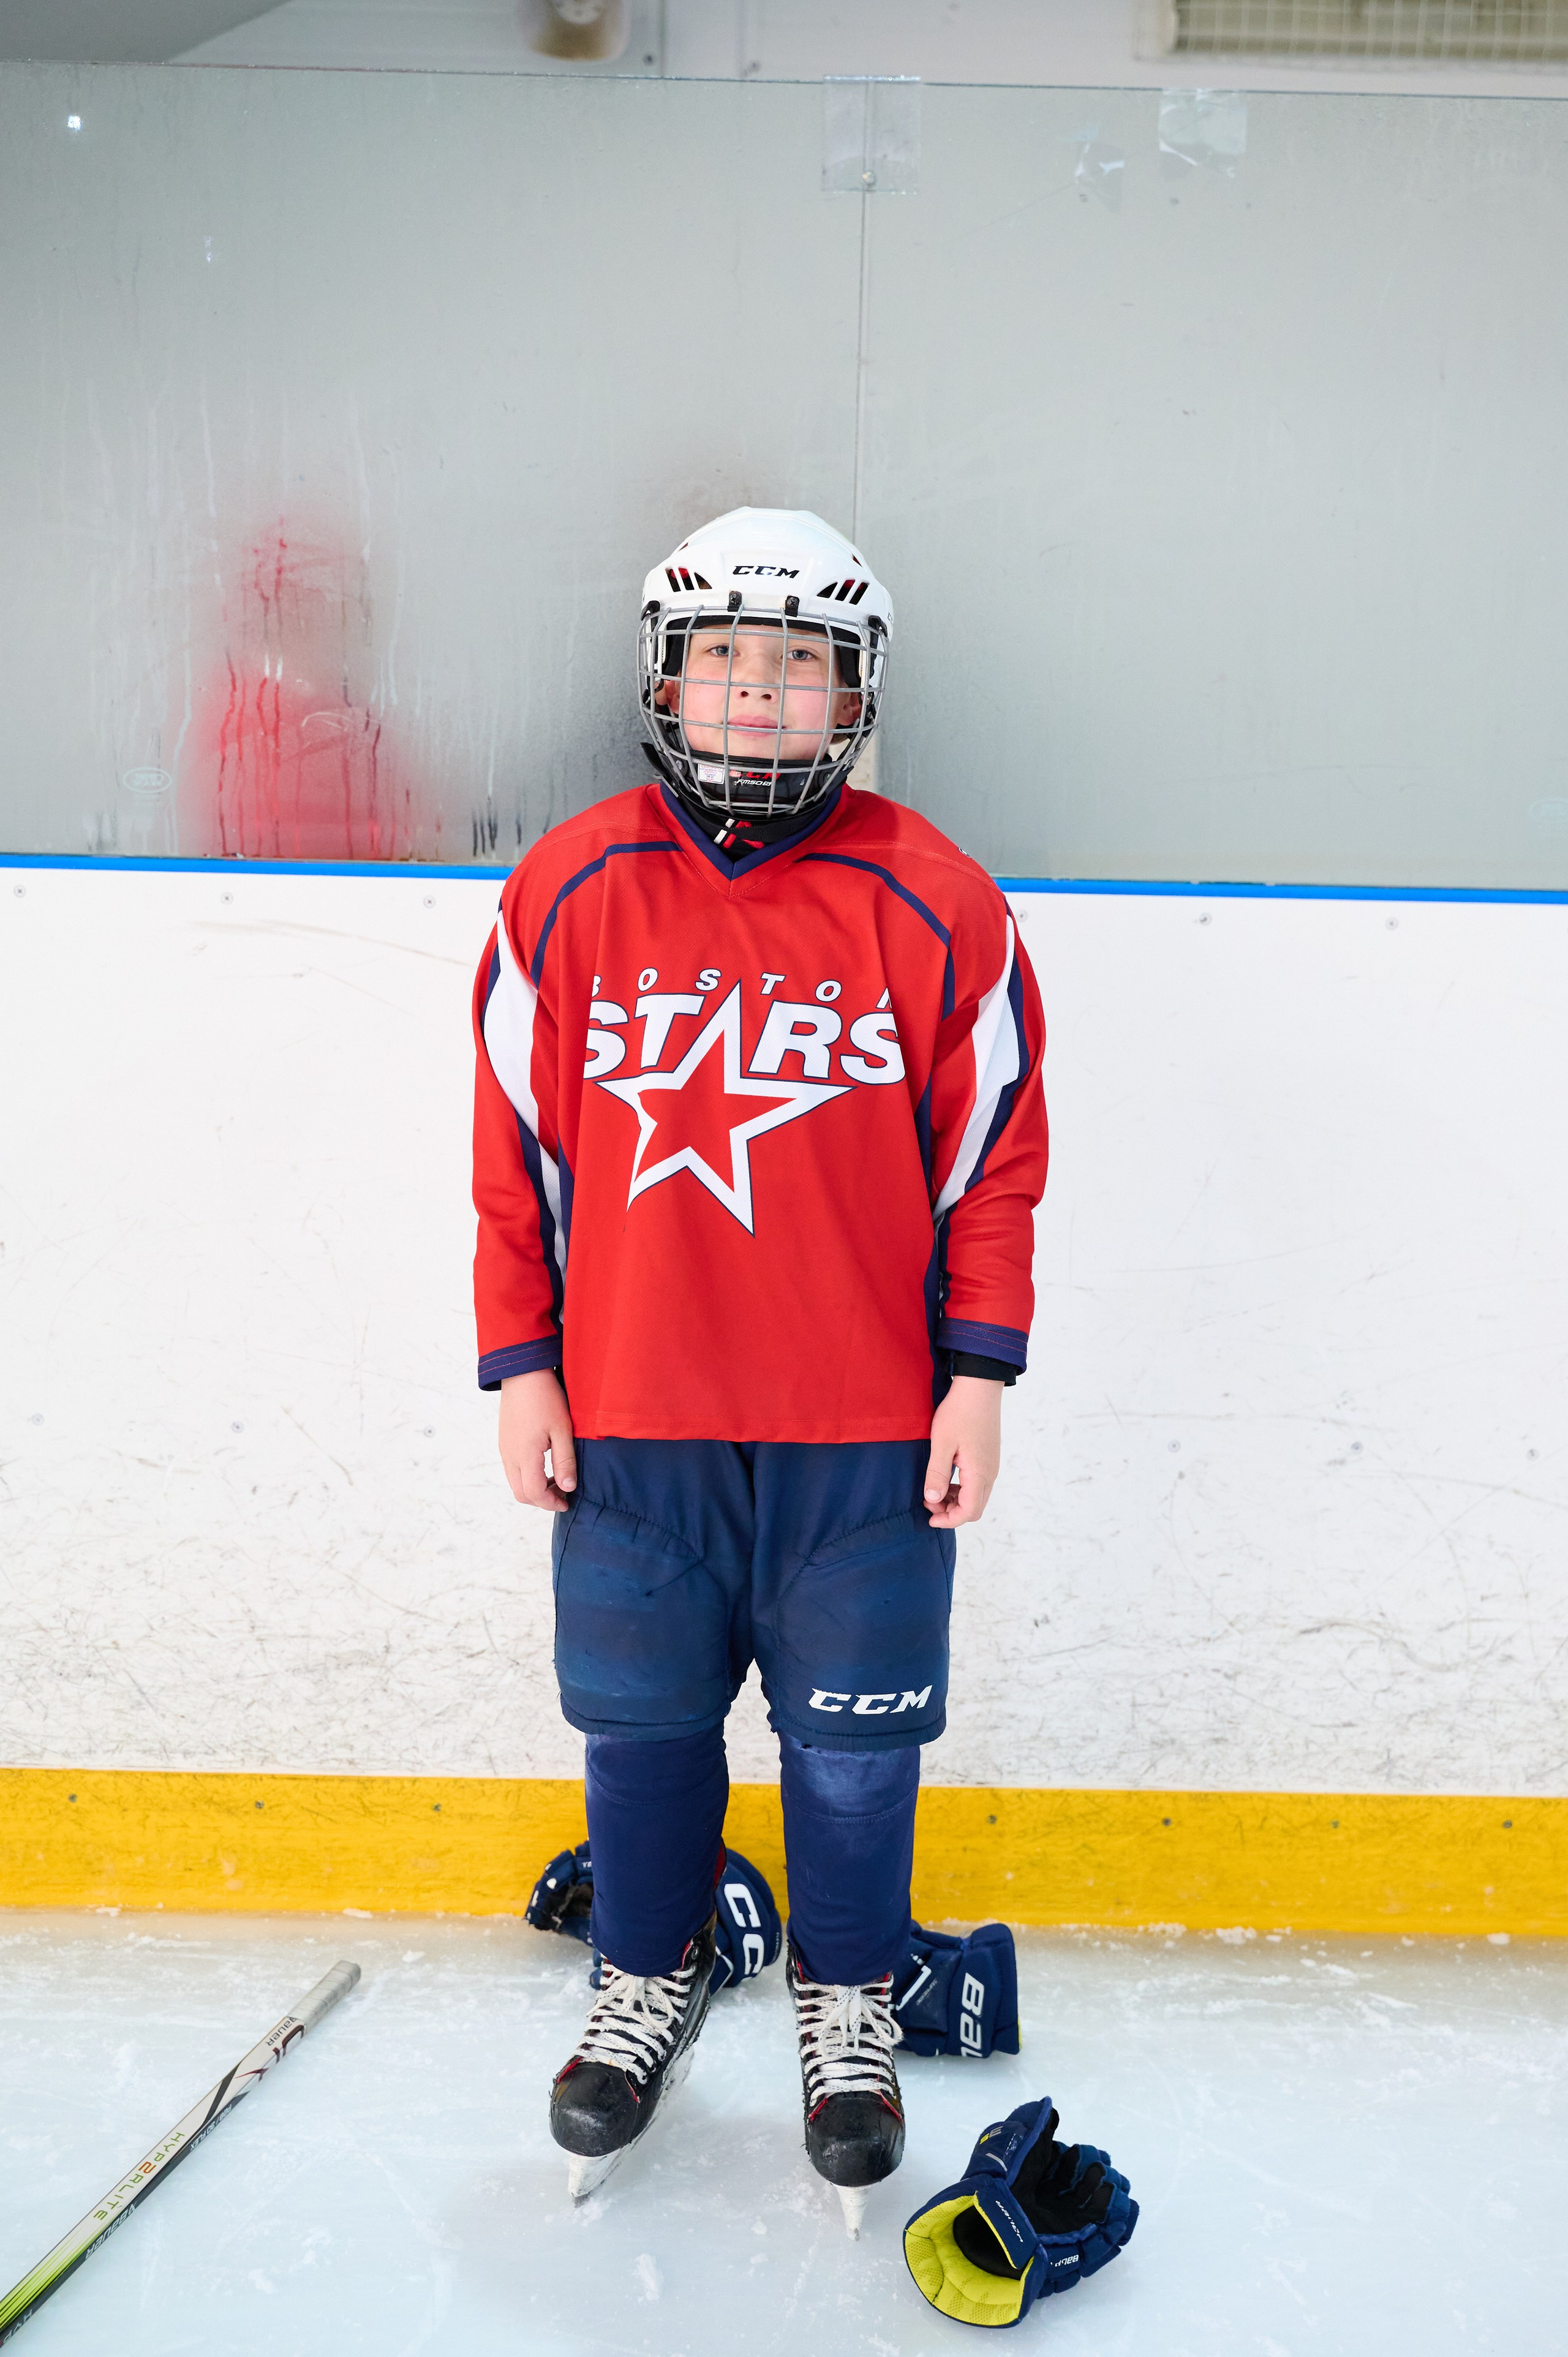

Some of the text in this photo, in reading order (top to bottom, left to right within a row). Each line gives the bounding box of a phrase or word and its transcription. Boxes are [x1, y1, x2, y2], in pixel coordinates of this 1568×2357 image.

[732, 565, 800, 578] CCM
[582, 978, 906, 1085] STARS
[808, 1684, 933, 1714] CCM
[93, 2132, 185, 2220] HYP2RLITE
[85, 2211, 128, 2260] BAUER
[0, 2308, 32, 2347] HYP
